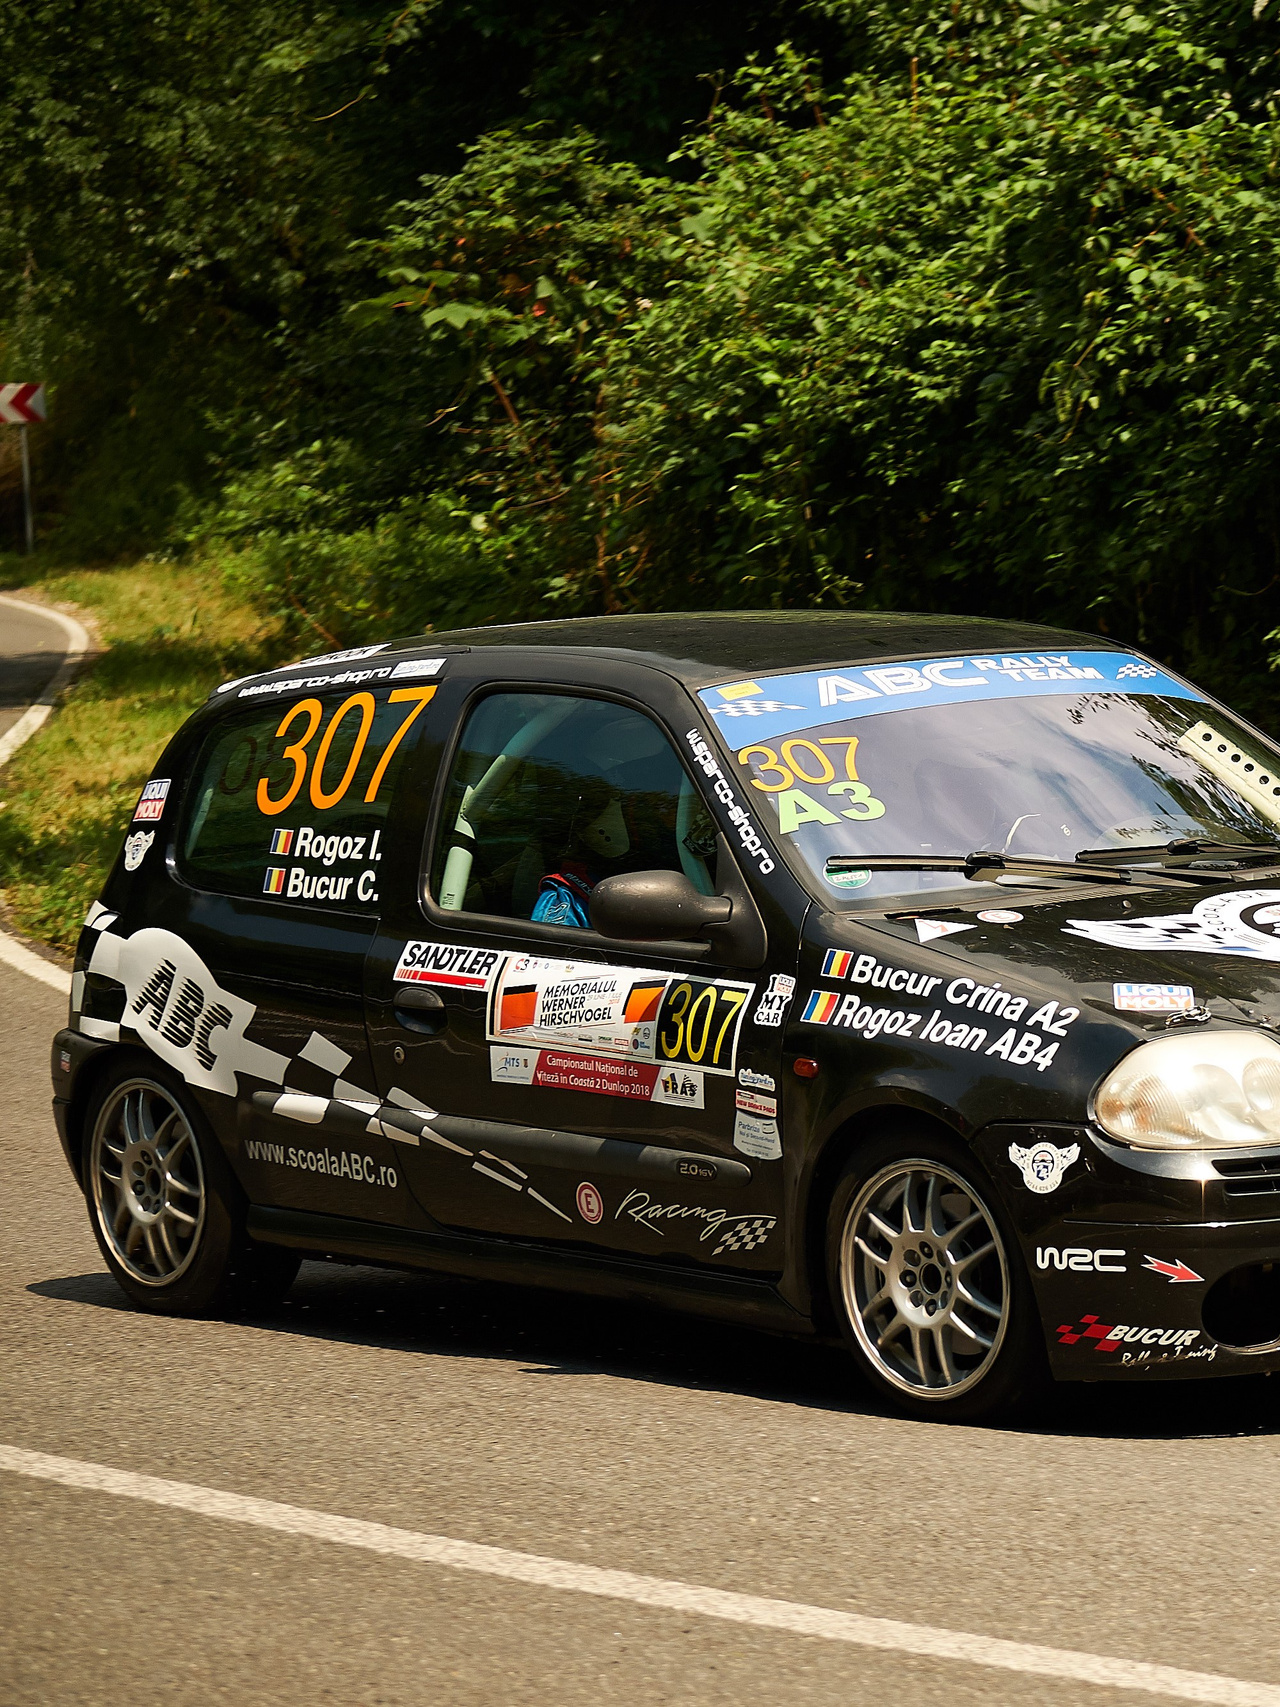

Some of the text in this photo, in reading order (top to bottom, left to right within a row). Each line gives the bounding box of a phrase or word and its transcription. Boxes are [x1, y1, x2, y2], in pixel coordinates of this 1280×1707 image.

[969, 655, 1073, 671] RALLY
[998, 667, 1105, 682] TEAM
[817, 660, 989, 707] ABC
[256, 685, 439, 816] 307
[737, 736, 859, 793] 307
[135, 801, 164, 818] MOLY
[779, 781, 886, 834] A3
[294, 827, 383, 866] Rogoz I.
[287, 867, 379, 901] Bucur C.
[403, 943, 499, 976] SANDTLER
[543, 980, 617, 999] MEMORIALUL
[850, 954, 1081, 1037] Bucur Crina A2
[1119, 984, 1189, 996] LIQUI
[542, 997, 585, 1013] WERNER
[760, 995, 790, 1010] MY
[1120, 996, 1191, 1008] MOLY
[131, 957, 234, 1072] ABC
[540, 1007, 612, 1027] HIRSCHVOGEL
[661, 982, 747, 1064] 307
[756, 1011, 780, 1024] CAR
[832, 994, 1061, 1073] Rogoz Ioan AB4
[546, 1055, 594, 1070] Campionatul
[628, 1066, 638, 1077] de
[595, 1079, 600, 1088] 2
[602, 1079, 630, 1095] Dunlop
[631, 1083, 650, 1096] 2018
[244, 1138, 398, 1188] www.scoalaABC.ro
[680, 1163, 698, 1175] 2.0
[615, 1188, 777, 1241] Racing
[1036, 1247, 1127, 1272] WRC
[1105, 1325, 1201, 1346] BUCUR
